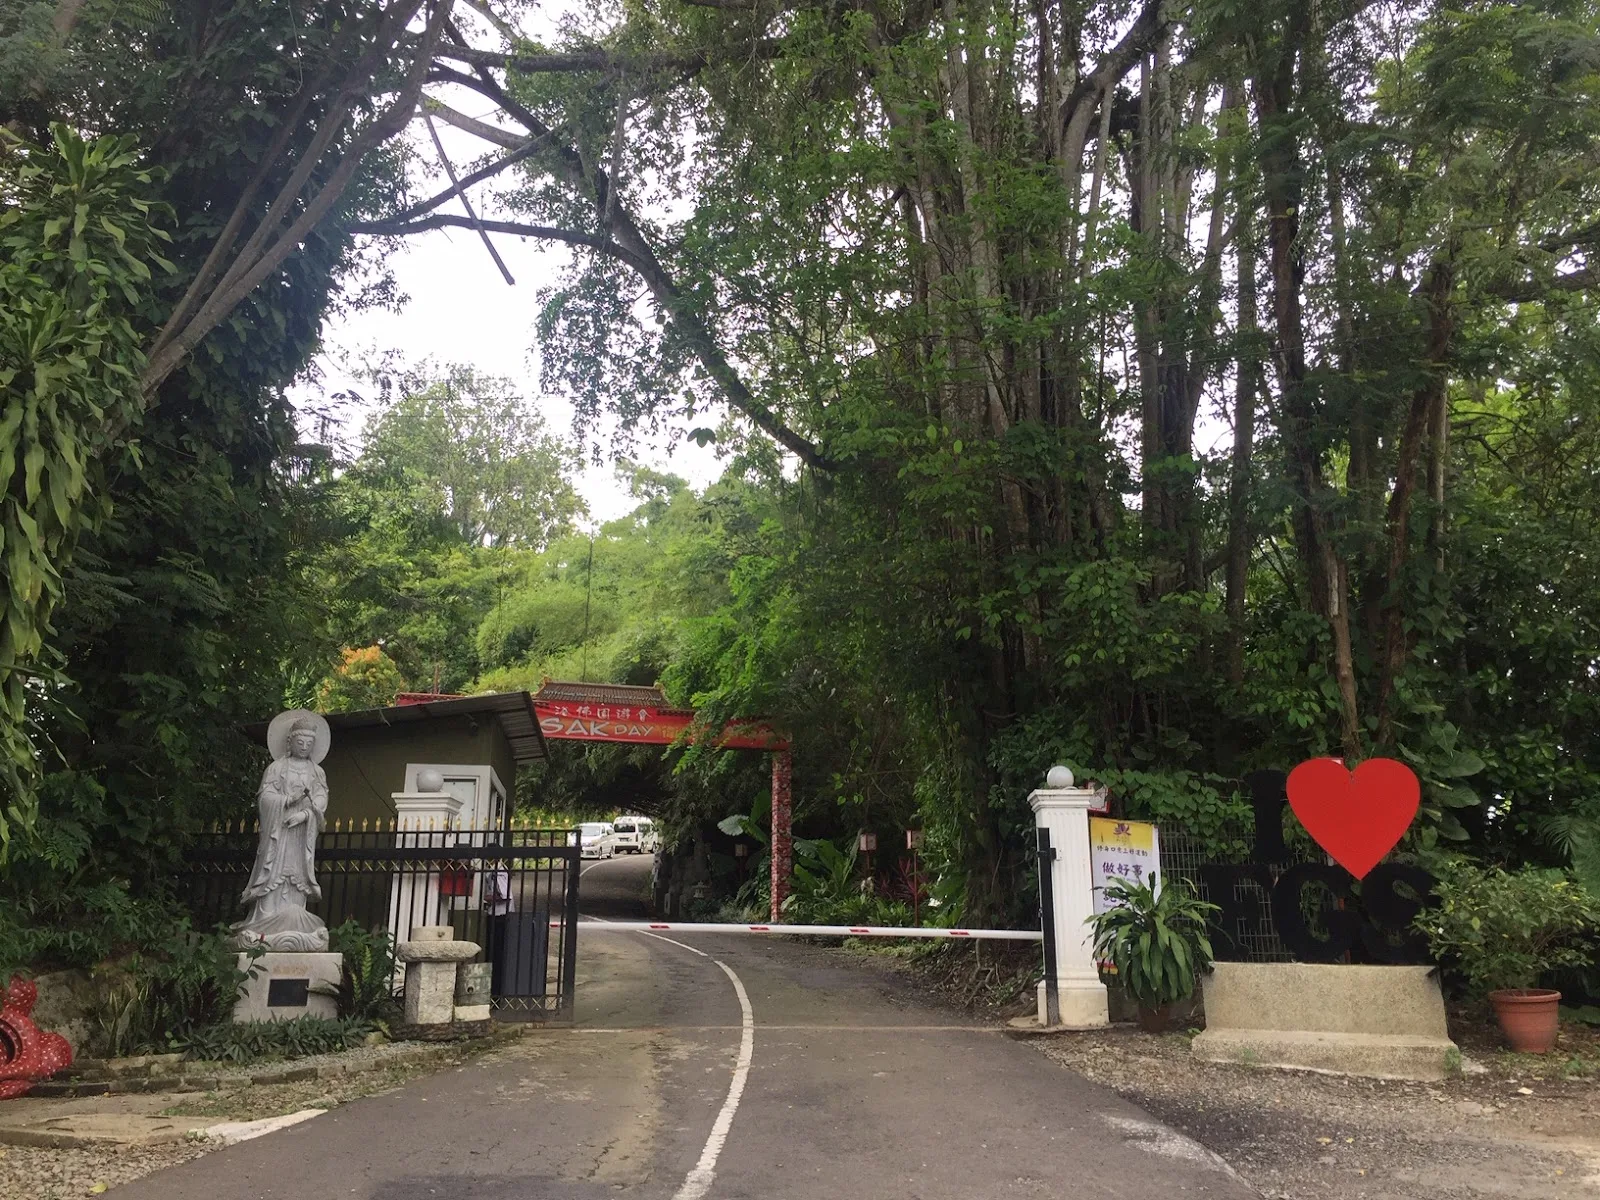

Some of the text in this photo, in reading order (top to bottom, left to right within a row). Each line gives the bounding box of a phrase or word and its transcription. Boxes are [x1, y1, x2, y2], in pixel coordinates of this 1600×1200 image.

[614, 724, 654, 736] DAY
[1102, 861, 1143, 877] 做好事
